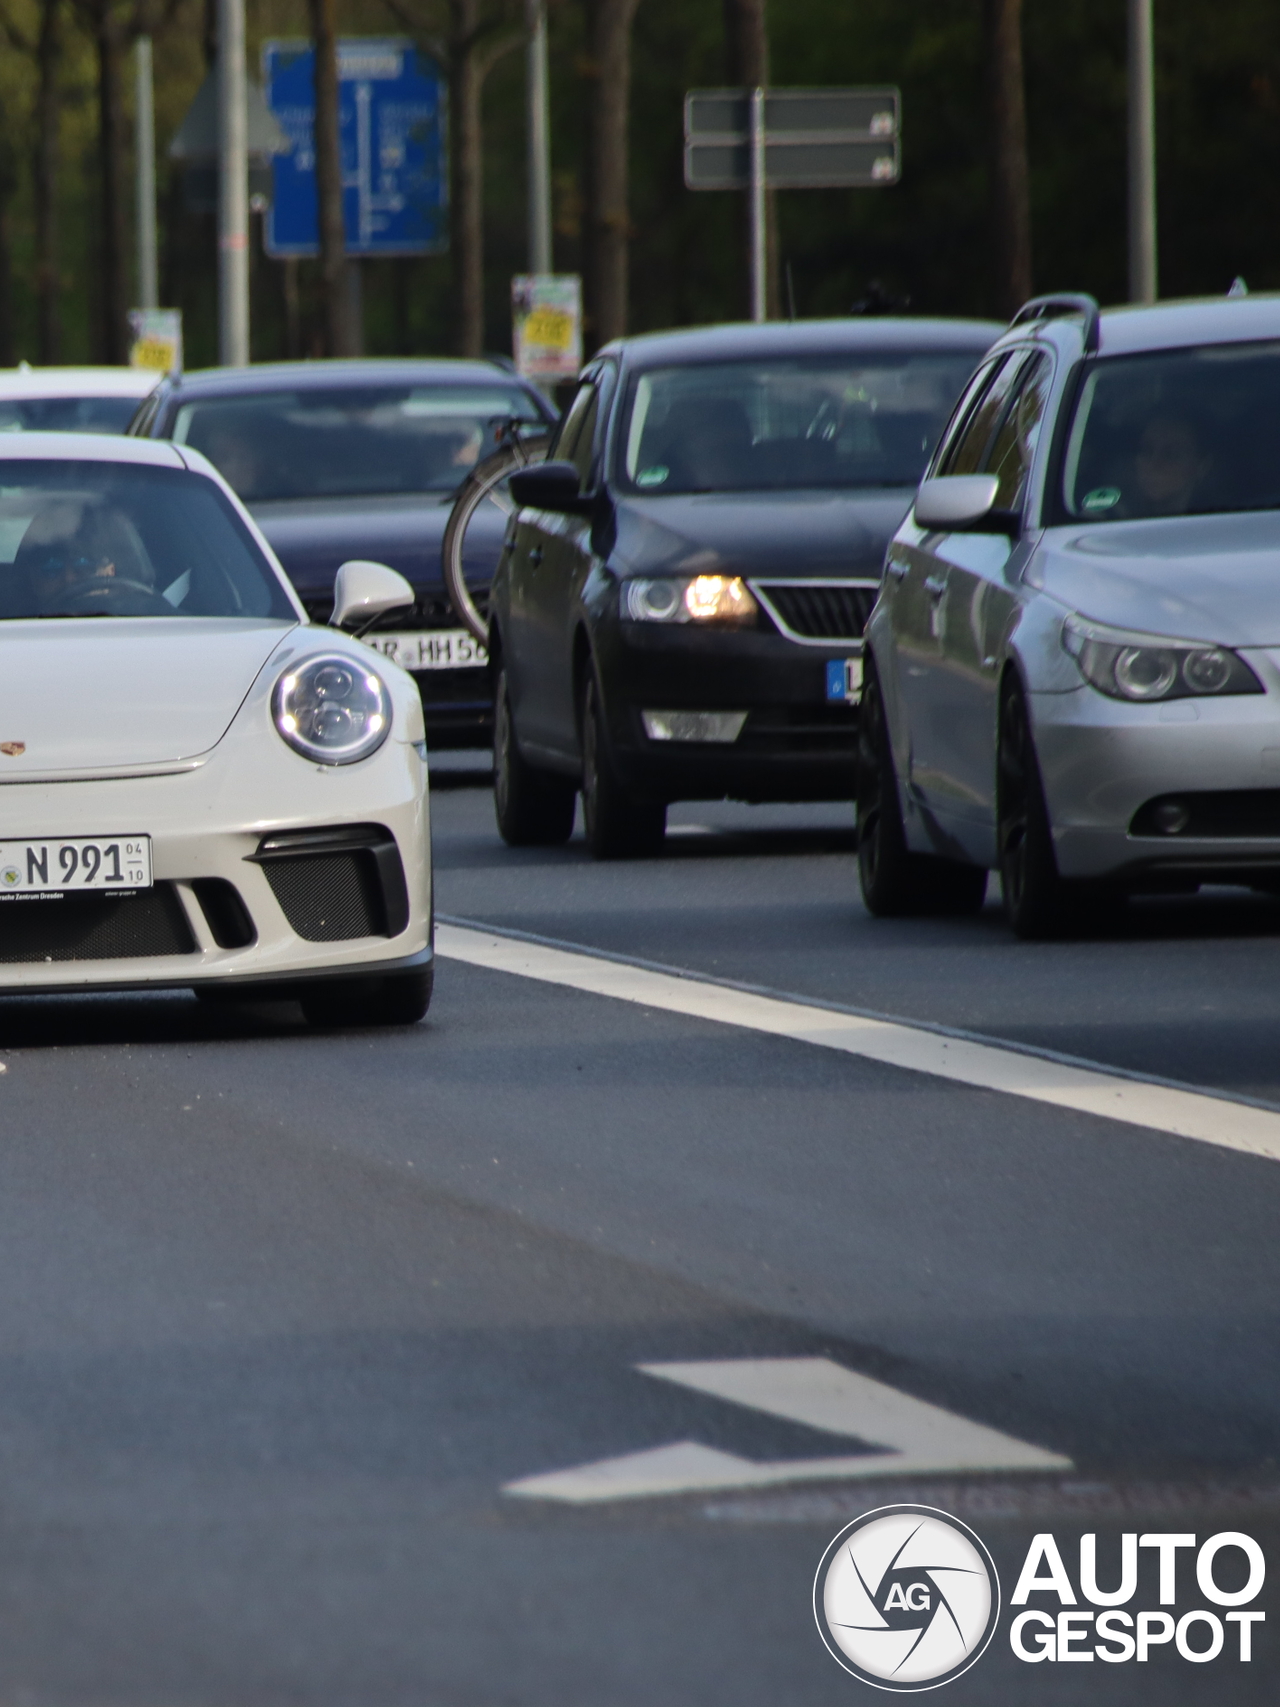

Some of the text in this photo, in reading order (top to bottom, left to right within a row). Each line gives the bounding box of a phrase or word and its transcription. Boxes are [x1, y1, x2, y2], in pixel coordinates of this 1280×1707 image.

[126, 843, 142, 855] 04
[27, 847, 48, 884] N
[59, 843, 124, 883] 991
[129, 870, 144, 881] 10
[15, 892, 39, 900] Zentrum
[40, 891, 64, 899] Dresden
